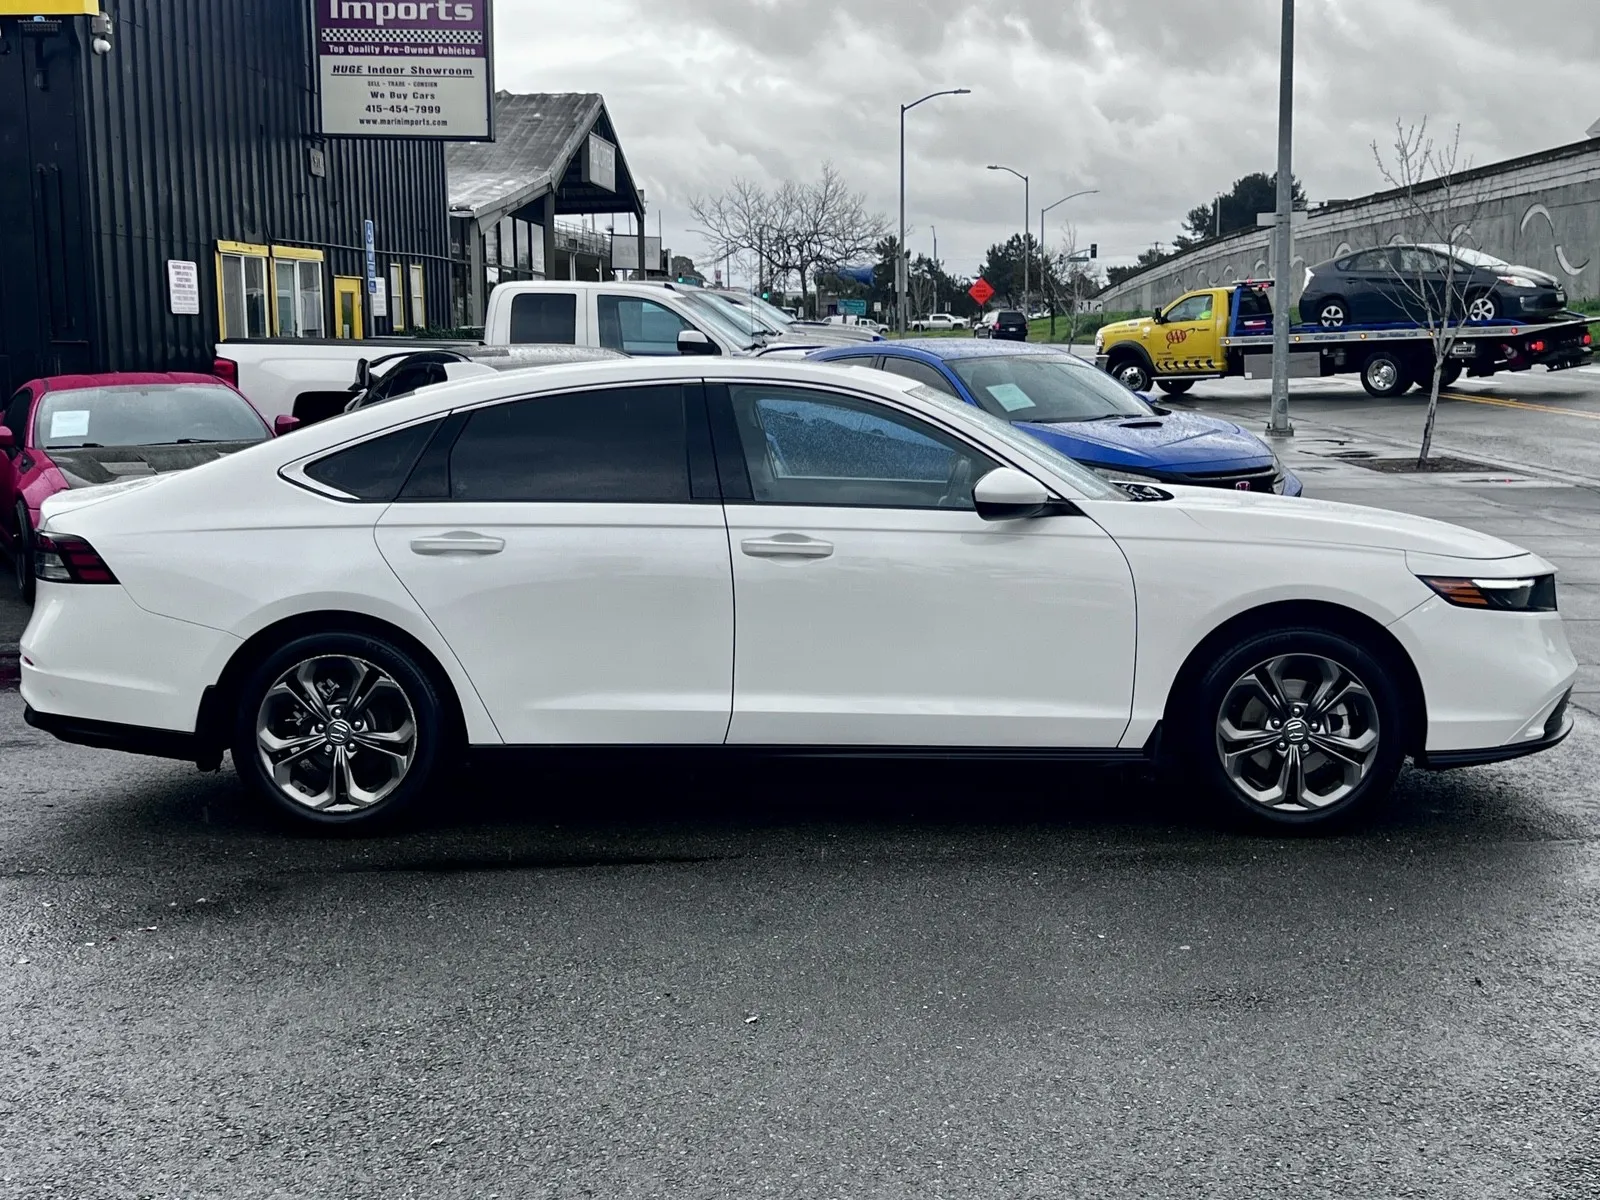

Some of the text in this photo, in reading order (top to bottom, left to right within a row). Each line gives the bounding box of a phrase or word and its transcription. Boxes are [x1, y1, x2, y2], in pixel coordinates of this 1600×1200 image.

[330, 0, 474, 26] Imports
[329, 44, 476, 55] Top Quality Pre-Owned Vehicles
[333, 65, 473, 75] HUGE Indoor Showroom
[370, 91, 436, 100] We Buy Cars
[365, 105, 441, 114] 415-454-7999
[359, 118, 448, 127] www.marinimports.com
